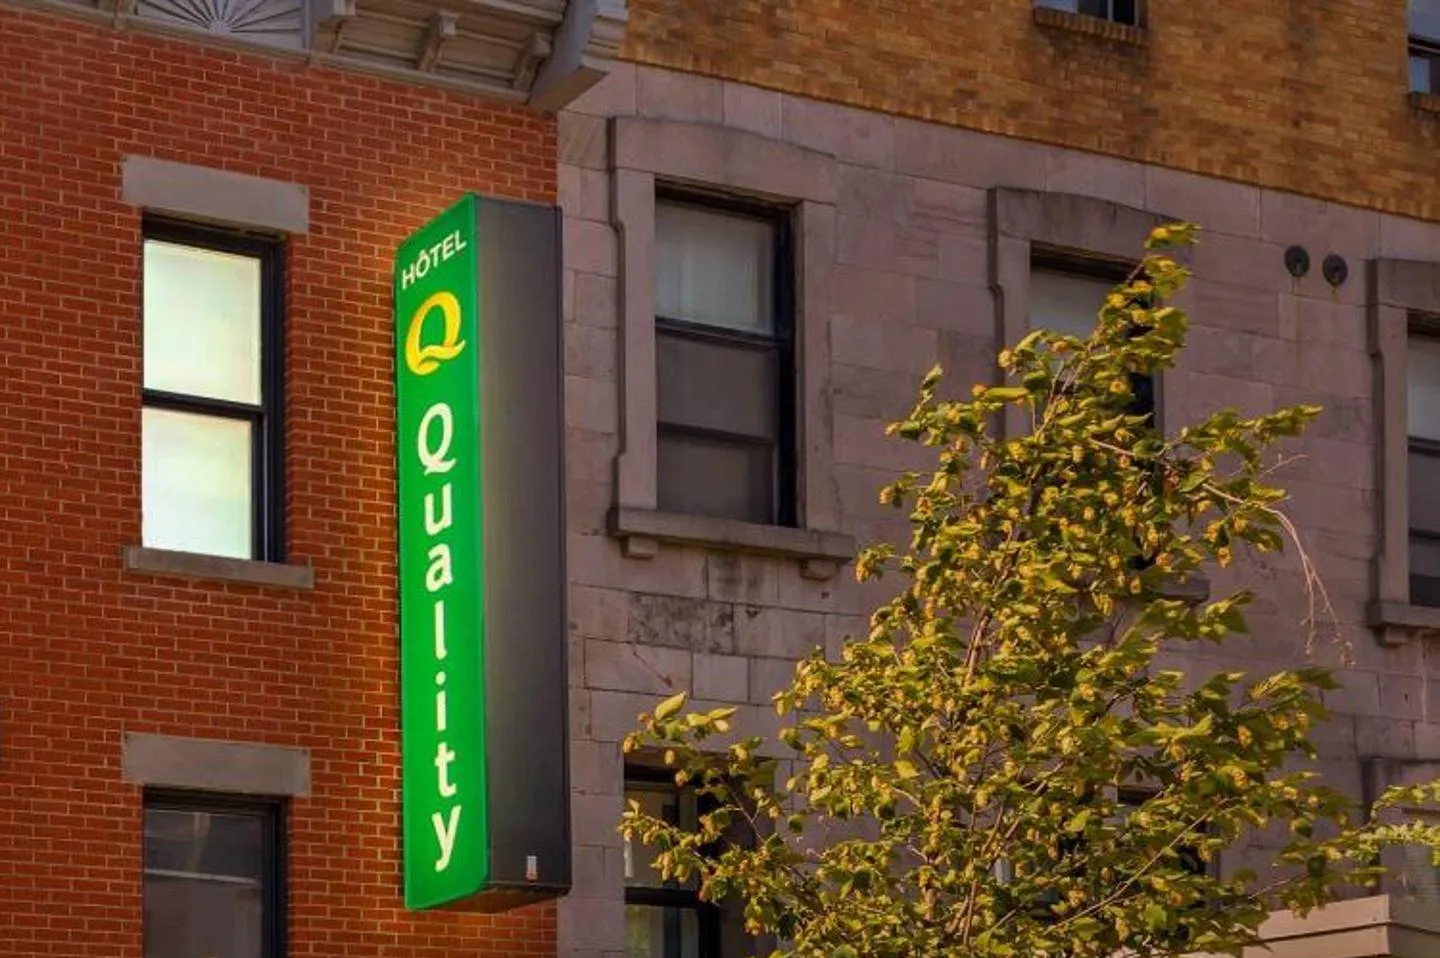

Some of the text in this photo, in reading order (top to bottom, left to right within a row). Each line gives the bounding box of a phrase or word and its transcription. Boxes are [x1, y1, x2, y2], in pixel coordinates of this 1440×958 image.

[401, 230, 467, 290] HÔTEL
[405, 291, 466, 375] Q
[417, 402, 462, 873] Quality
